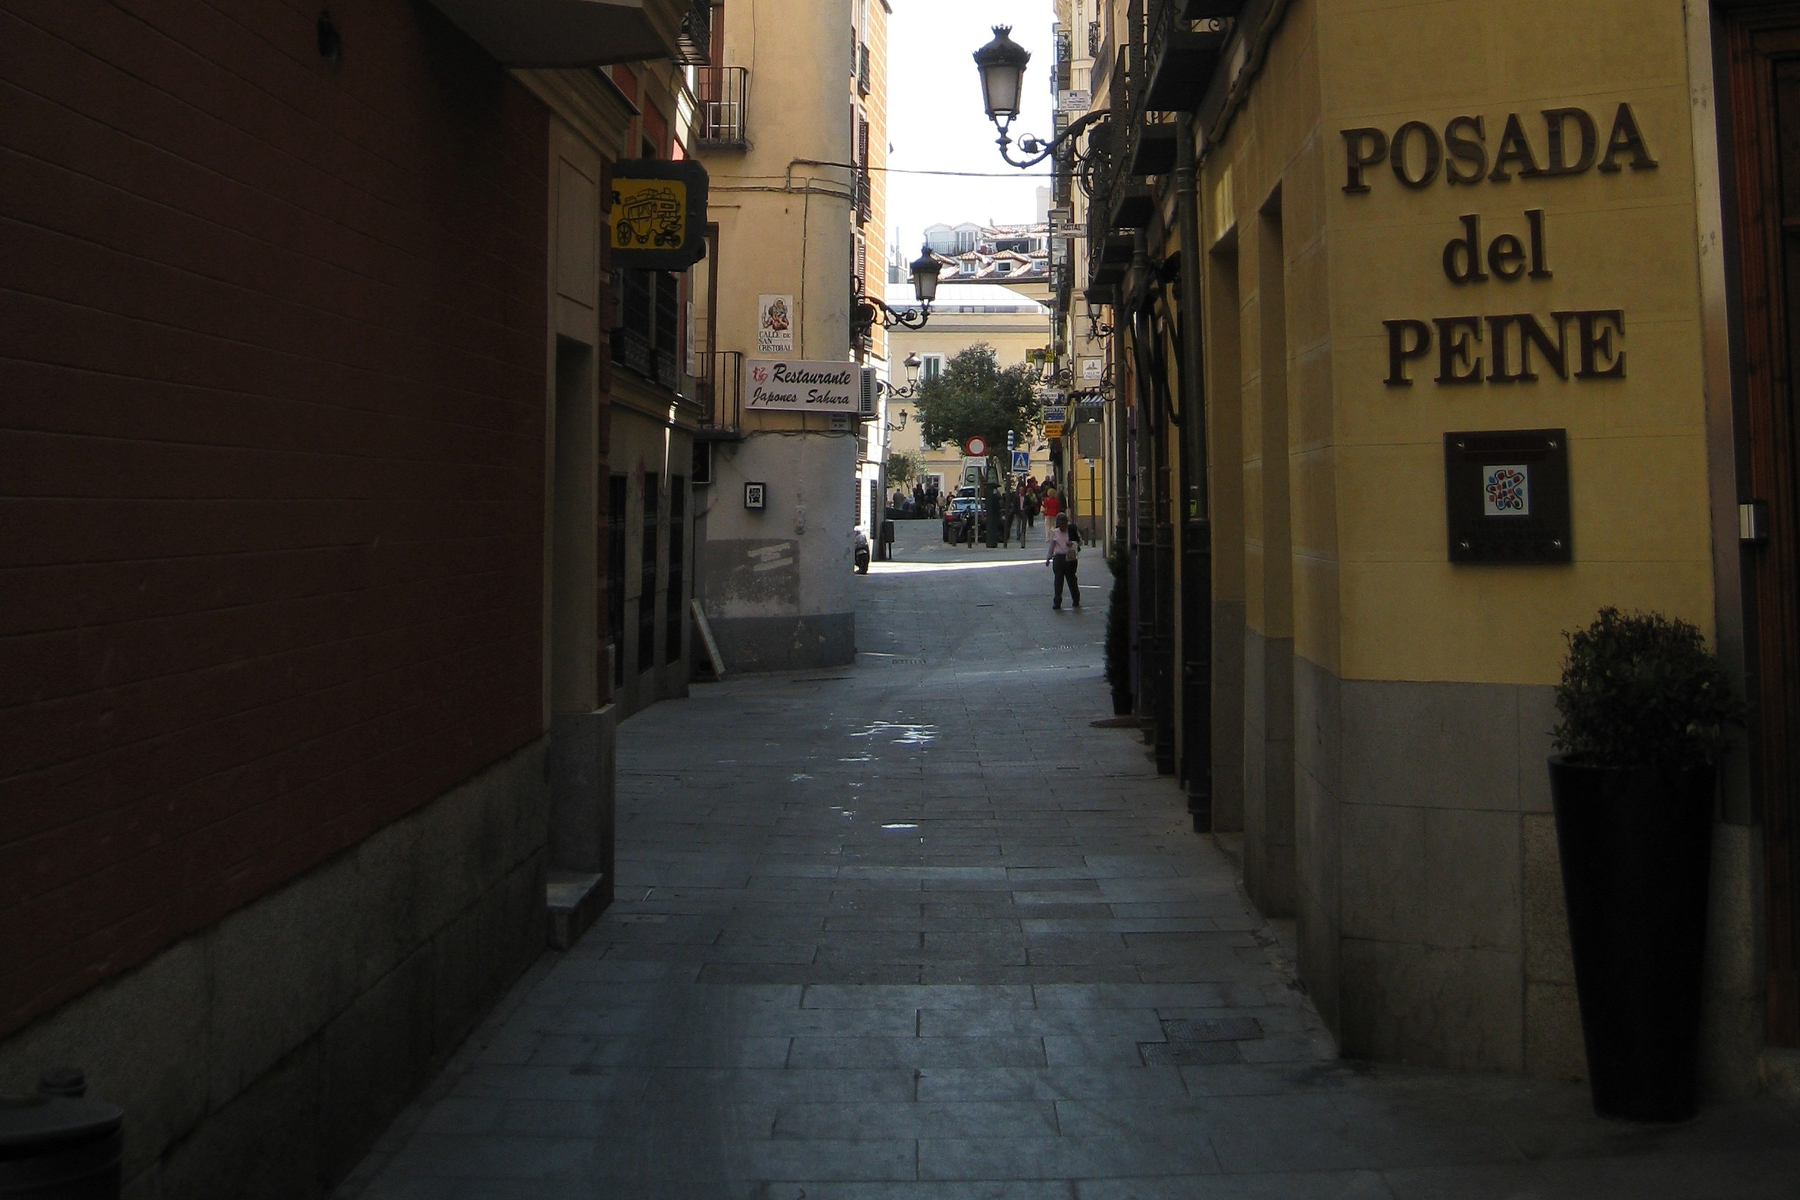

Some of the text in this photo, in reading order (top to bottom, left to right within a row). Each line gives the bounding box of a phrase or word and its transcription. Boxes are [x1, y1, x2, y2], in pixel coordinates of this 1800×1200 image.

[1340, 102, 1658, 193] POSADA
[1442, 209, 1553, 285] del
[772, 362, 852, 385] Restaurante
[1382, 309, 1627, 386] PEINE
[751, 386, 851, 405] Japones Sakura
